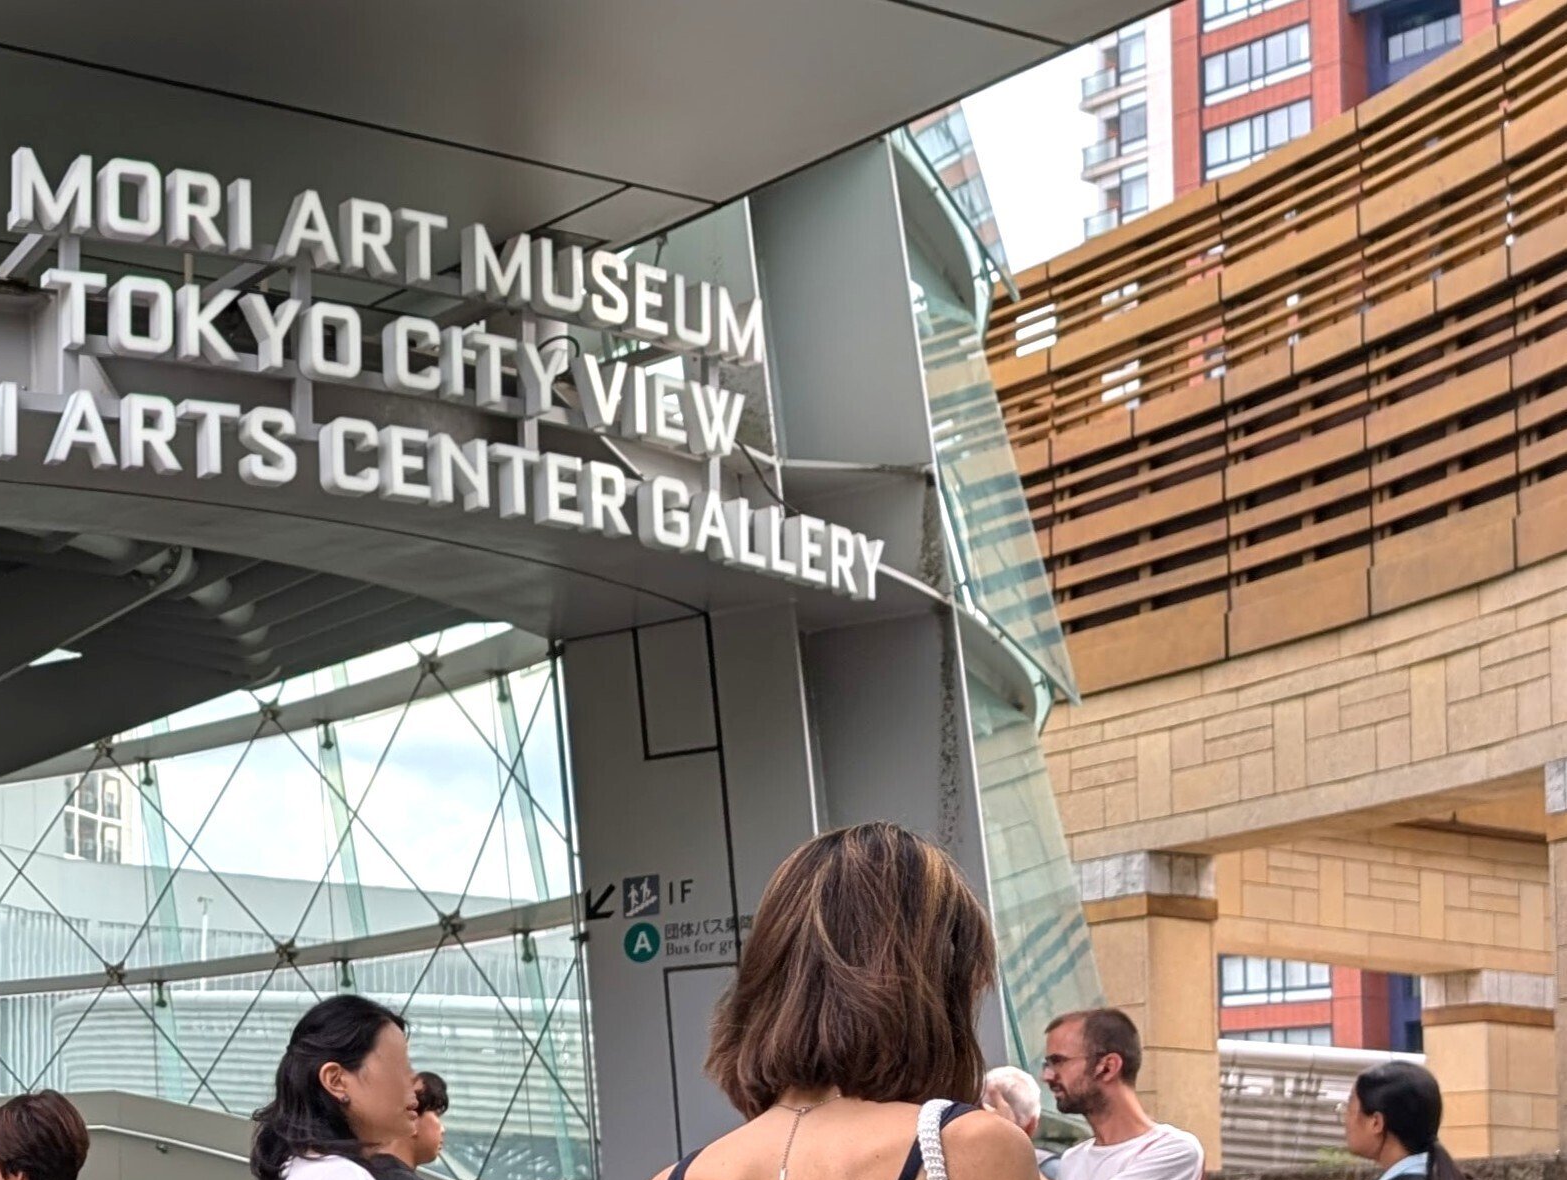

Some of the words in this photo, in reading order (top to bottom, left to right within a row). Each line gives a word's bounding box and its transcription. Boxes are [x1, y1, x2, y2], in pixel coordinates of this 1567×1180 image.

[8, 146, 251, 254] MORI
[284, 188, 447, 286] ART
[462, 221, 764, 366] MUSEUM
[42, 267, 361, 382] TOKYO
[382, 314, 567, 417] CITY
[581, 350, 747, 457] VIEW
[44, 390, 297, 488] ARTS
[319, 417, 631, 537] CENTER
[637, 474, 884, 600] GALLERY
[633, 930, 653, 955] A
[666, 942, 690, 956] Bus
[694, 939, 715, 953] for
